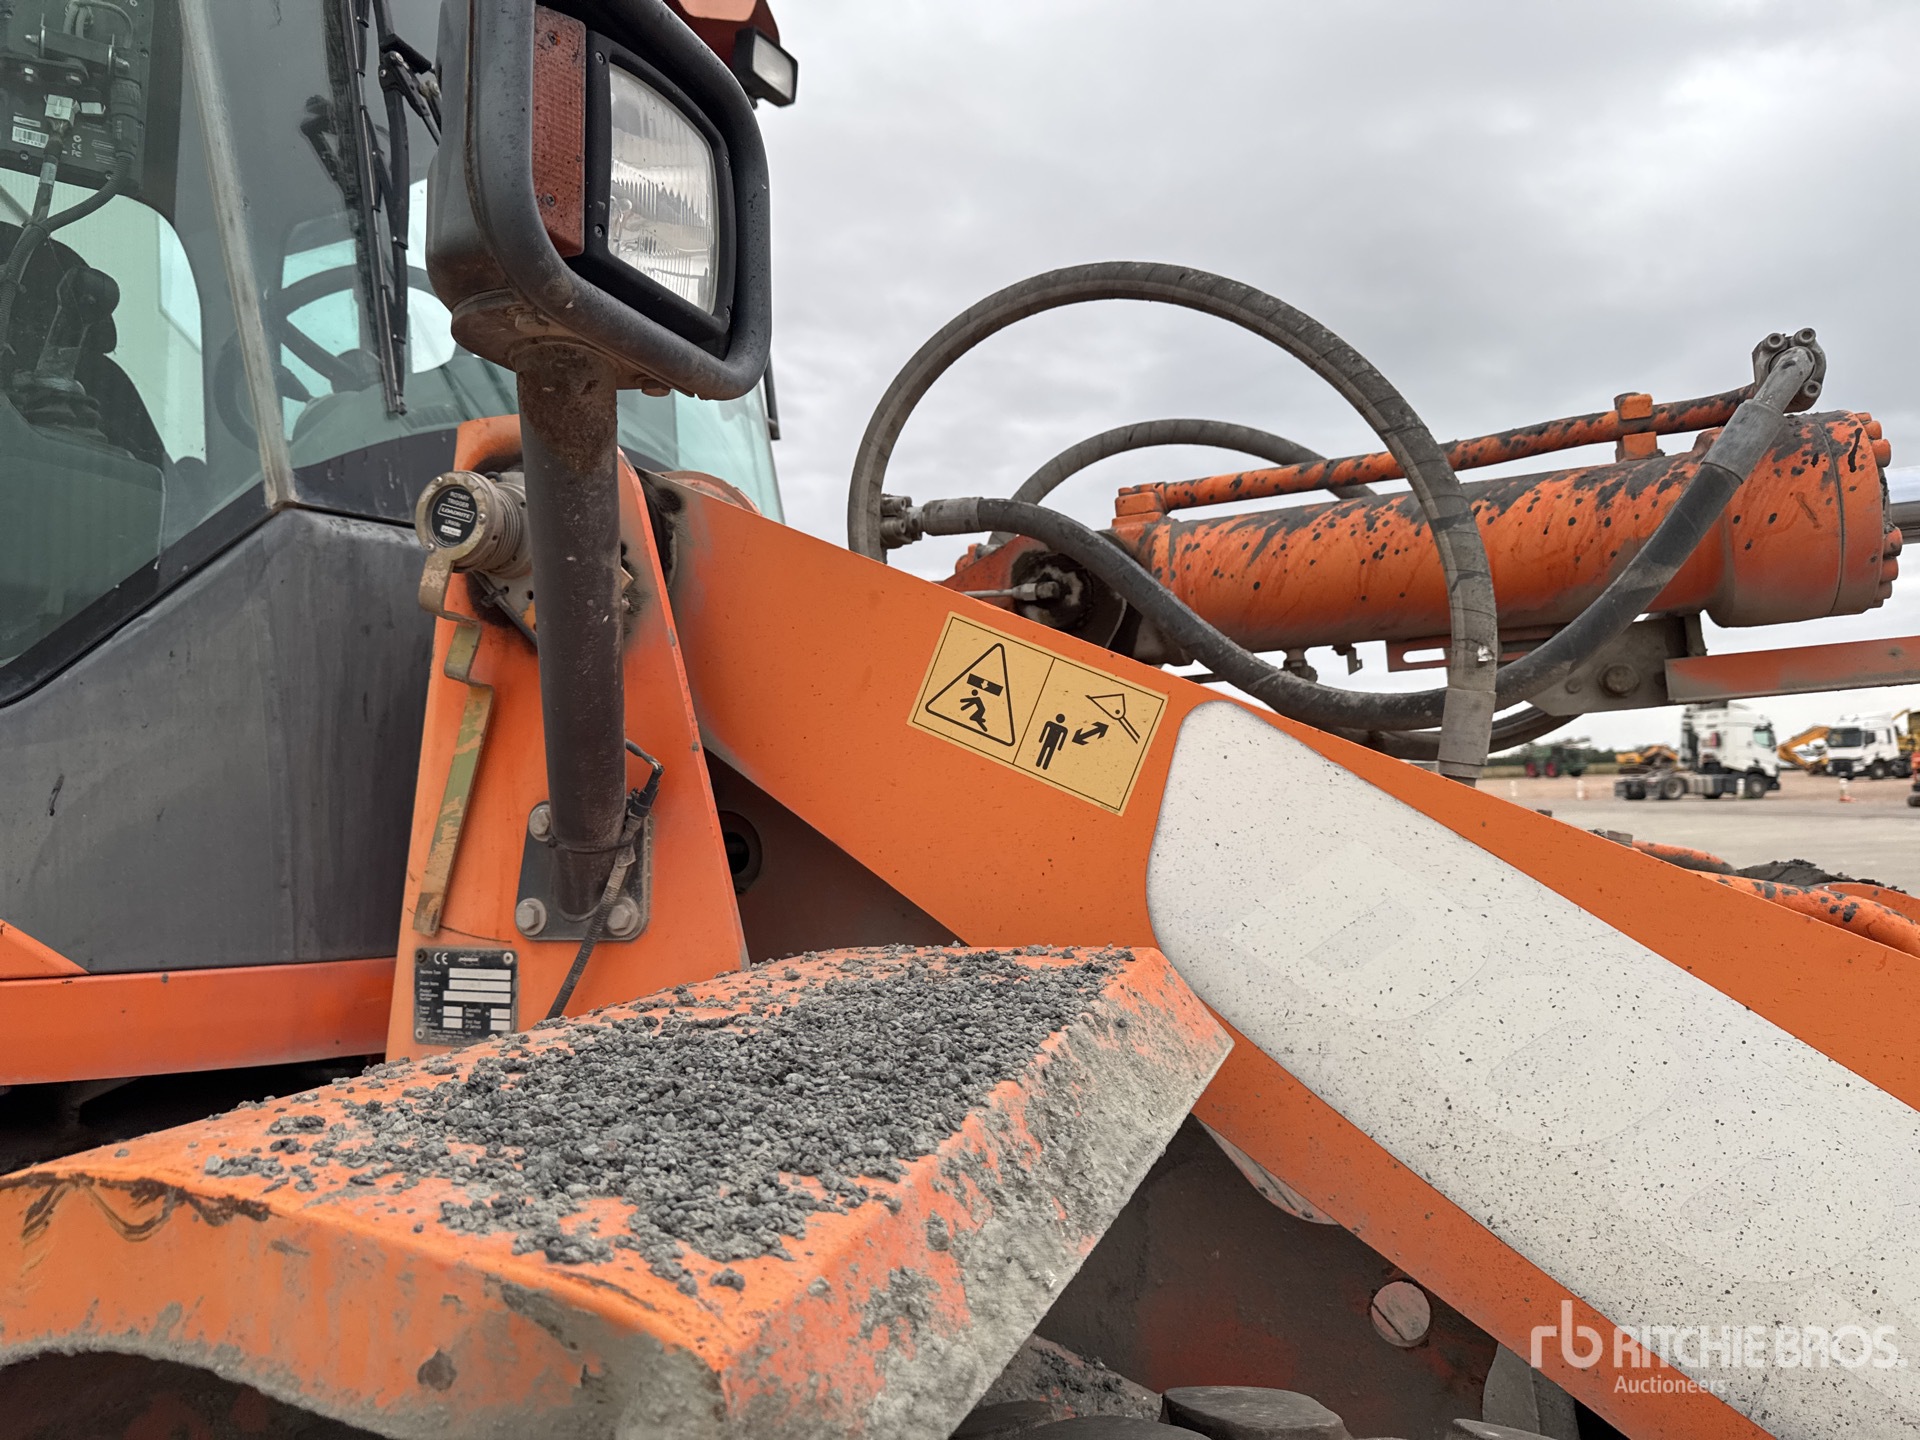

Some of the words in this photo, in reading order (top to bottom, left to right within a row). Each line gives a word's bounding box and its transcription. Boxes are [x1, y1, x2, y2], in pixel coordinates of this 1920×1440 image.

[450, 491, 470, 501] ROTARY
[446, 497, 470, 509] TRIGGER
[441, 507, 471, 519] LOADRITE
[434, 952, 448, 965] CE
